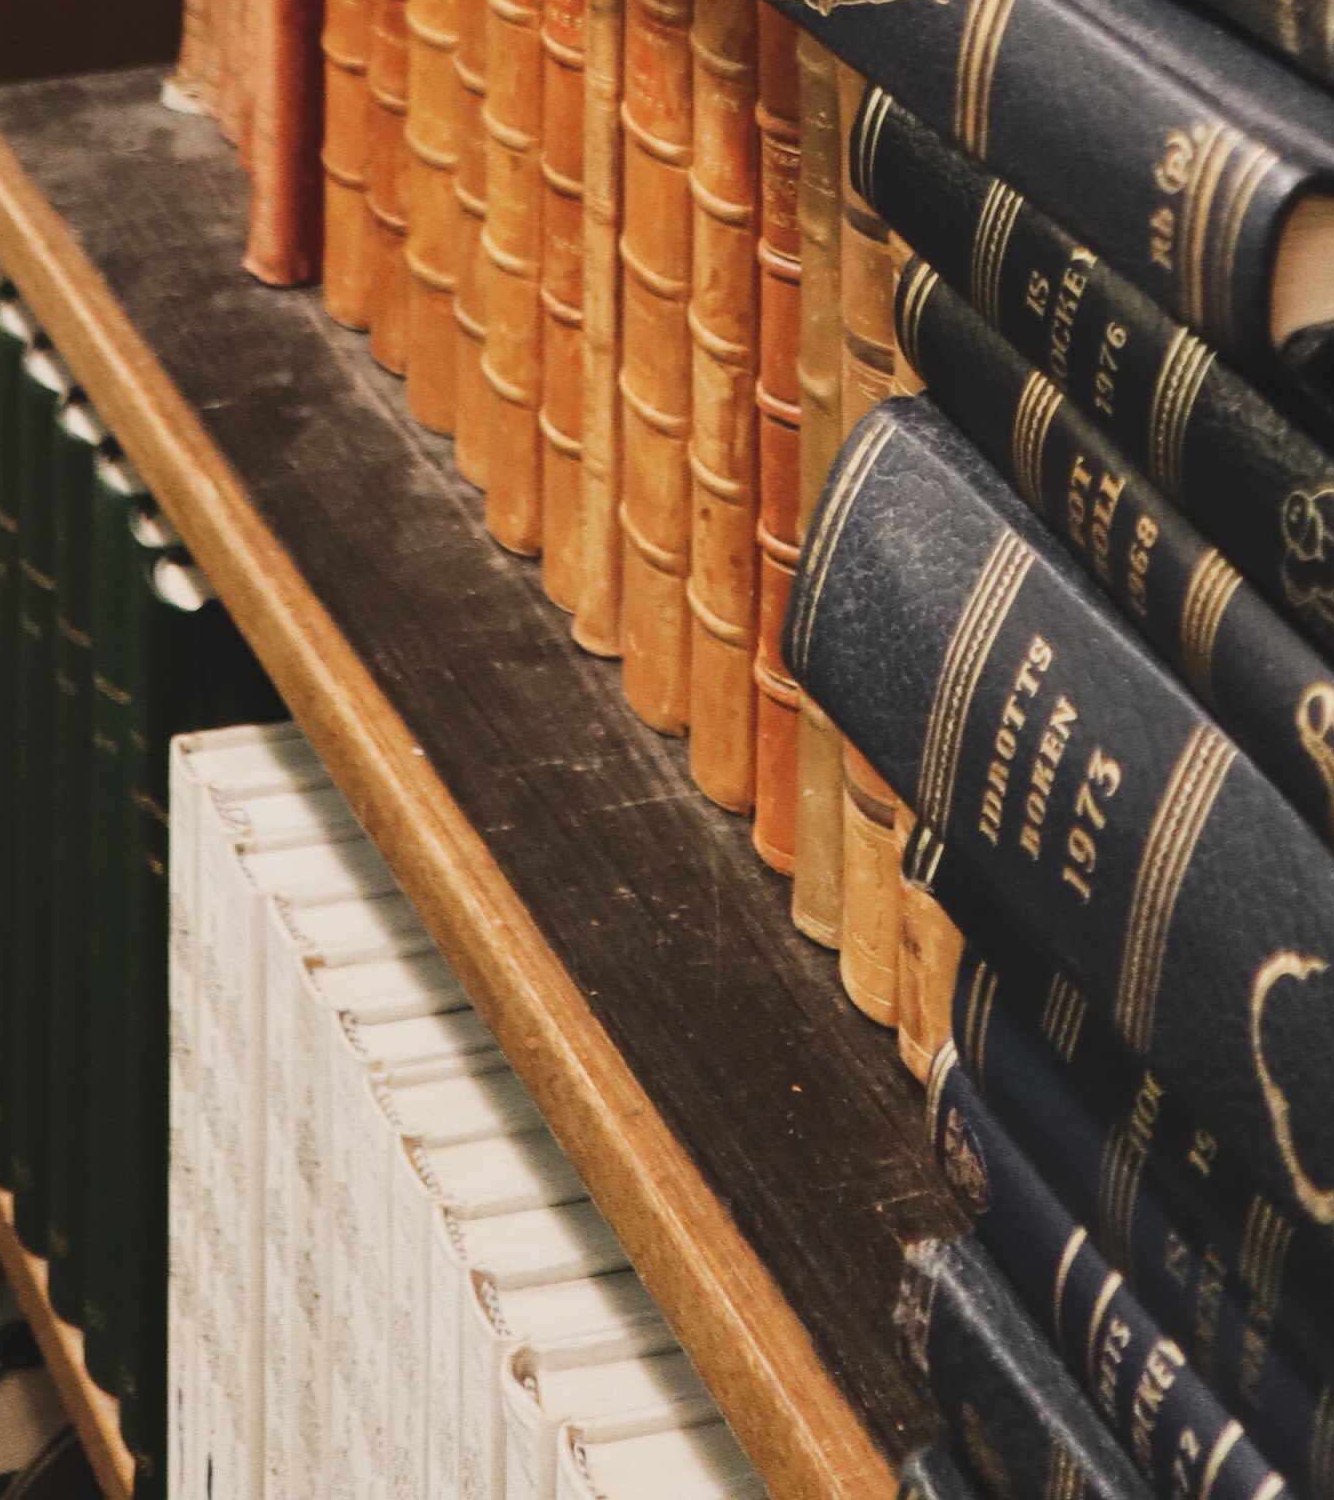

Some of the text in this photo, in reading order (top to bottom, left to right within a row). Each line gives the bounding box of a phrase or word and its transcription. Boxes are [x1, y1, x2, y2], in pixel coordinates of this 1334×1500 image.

[1026, 269, 1051, 318] IS
[1050, 245, 1099, 382] OCKEY
[1094, 320, 1129, 418] 1976
[978, 633, 1053, 848] IDROTTS
[1019, 694, 1079, 862] BOKEN
[1063, 747, 1122, 905] 1973
